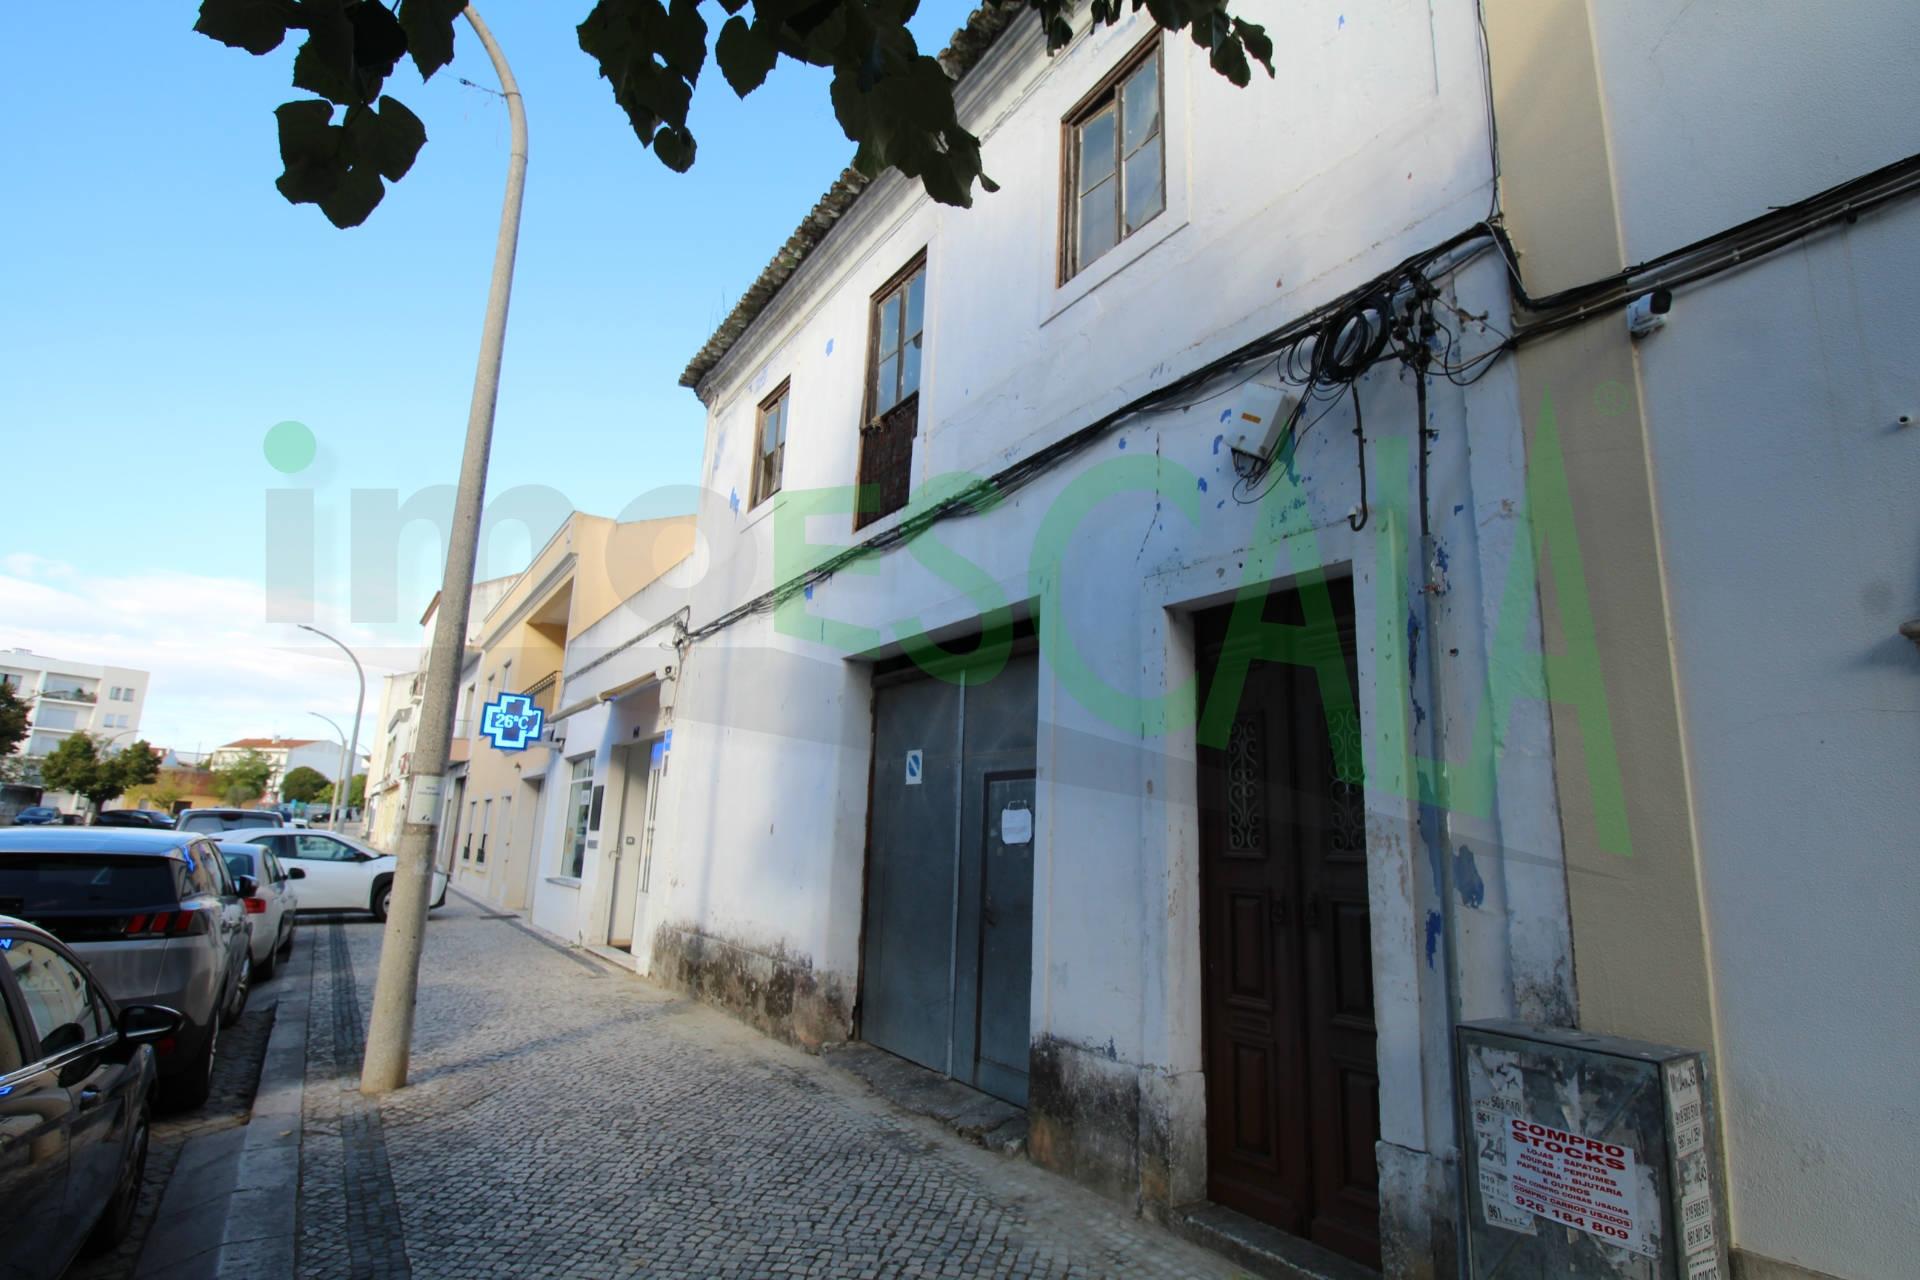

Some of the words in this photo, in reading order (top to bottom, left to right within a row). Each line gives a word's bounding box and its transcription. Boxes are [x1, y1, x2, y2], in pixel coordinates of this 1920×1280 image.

[494, 713, 530, 730] 26°C
[1511, 1119, 1625, 1158] COMPRO
[1512, 1131, 1626, 1171] STOCKS
[1516, 1160, 1562, 1180] PAPELARIA
[1571, 1178, 1623, 1197] BIJUTARIA
[1520, 1153, 1554, 1169] ROUPAS
[1563, 1167, 1617, 1187] PERFUMES
[1526, 1147, 1554, 1161] LOJAS
[1563, 1158, 1608, 1175] SAPATOS
[1513, 1185, 1548, 1201] COMPRO
[1549, 1197, 1587, 1214] CARROS
[1589, 1210, 1630, 1227] USADOS
[1528, 1180, 1560, 1195] COMPRO
[1561, 1192, 1593, 1205] COISAS
[1594, 1201, 1630, 1215] USADAS
[1550, 1180, 1591, 1196] OUTROS
[1515, 1195, 1545, 1213] 926
[1551, 1209, 1585, 1227] 184
[1591, 1221, 1629, 1240] 809
